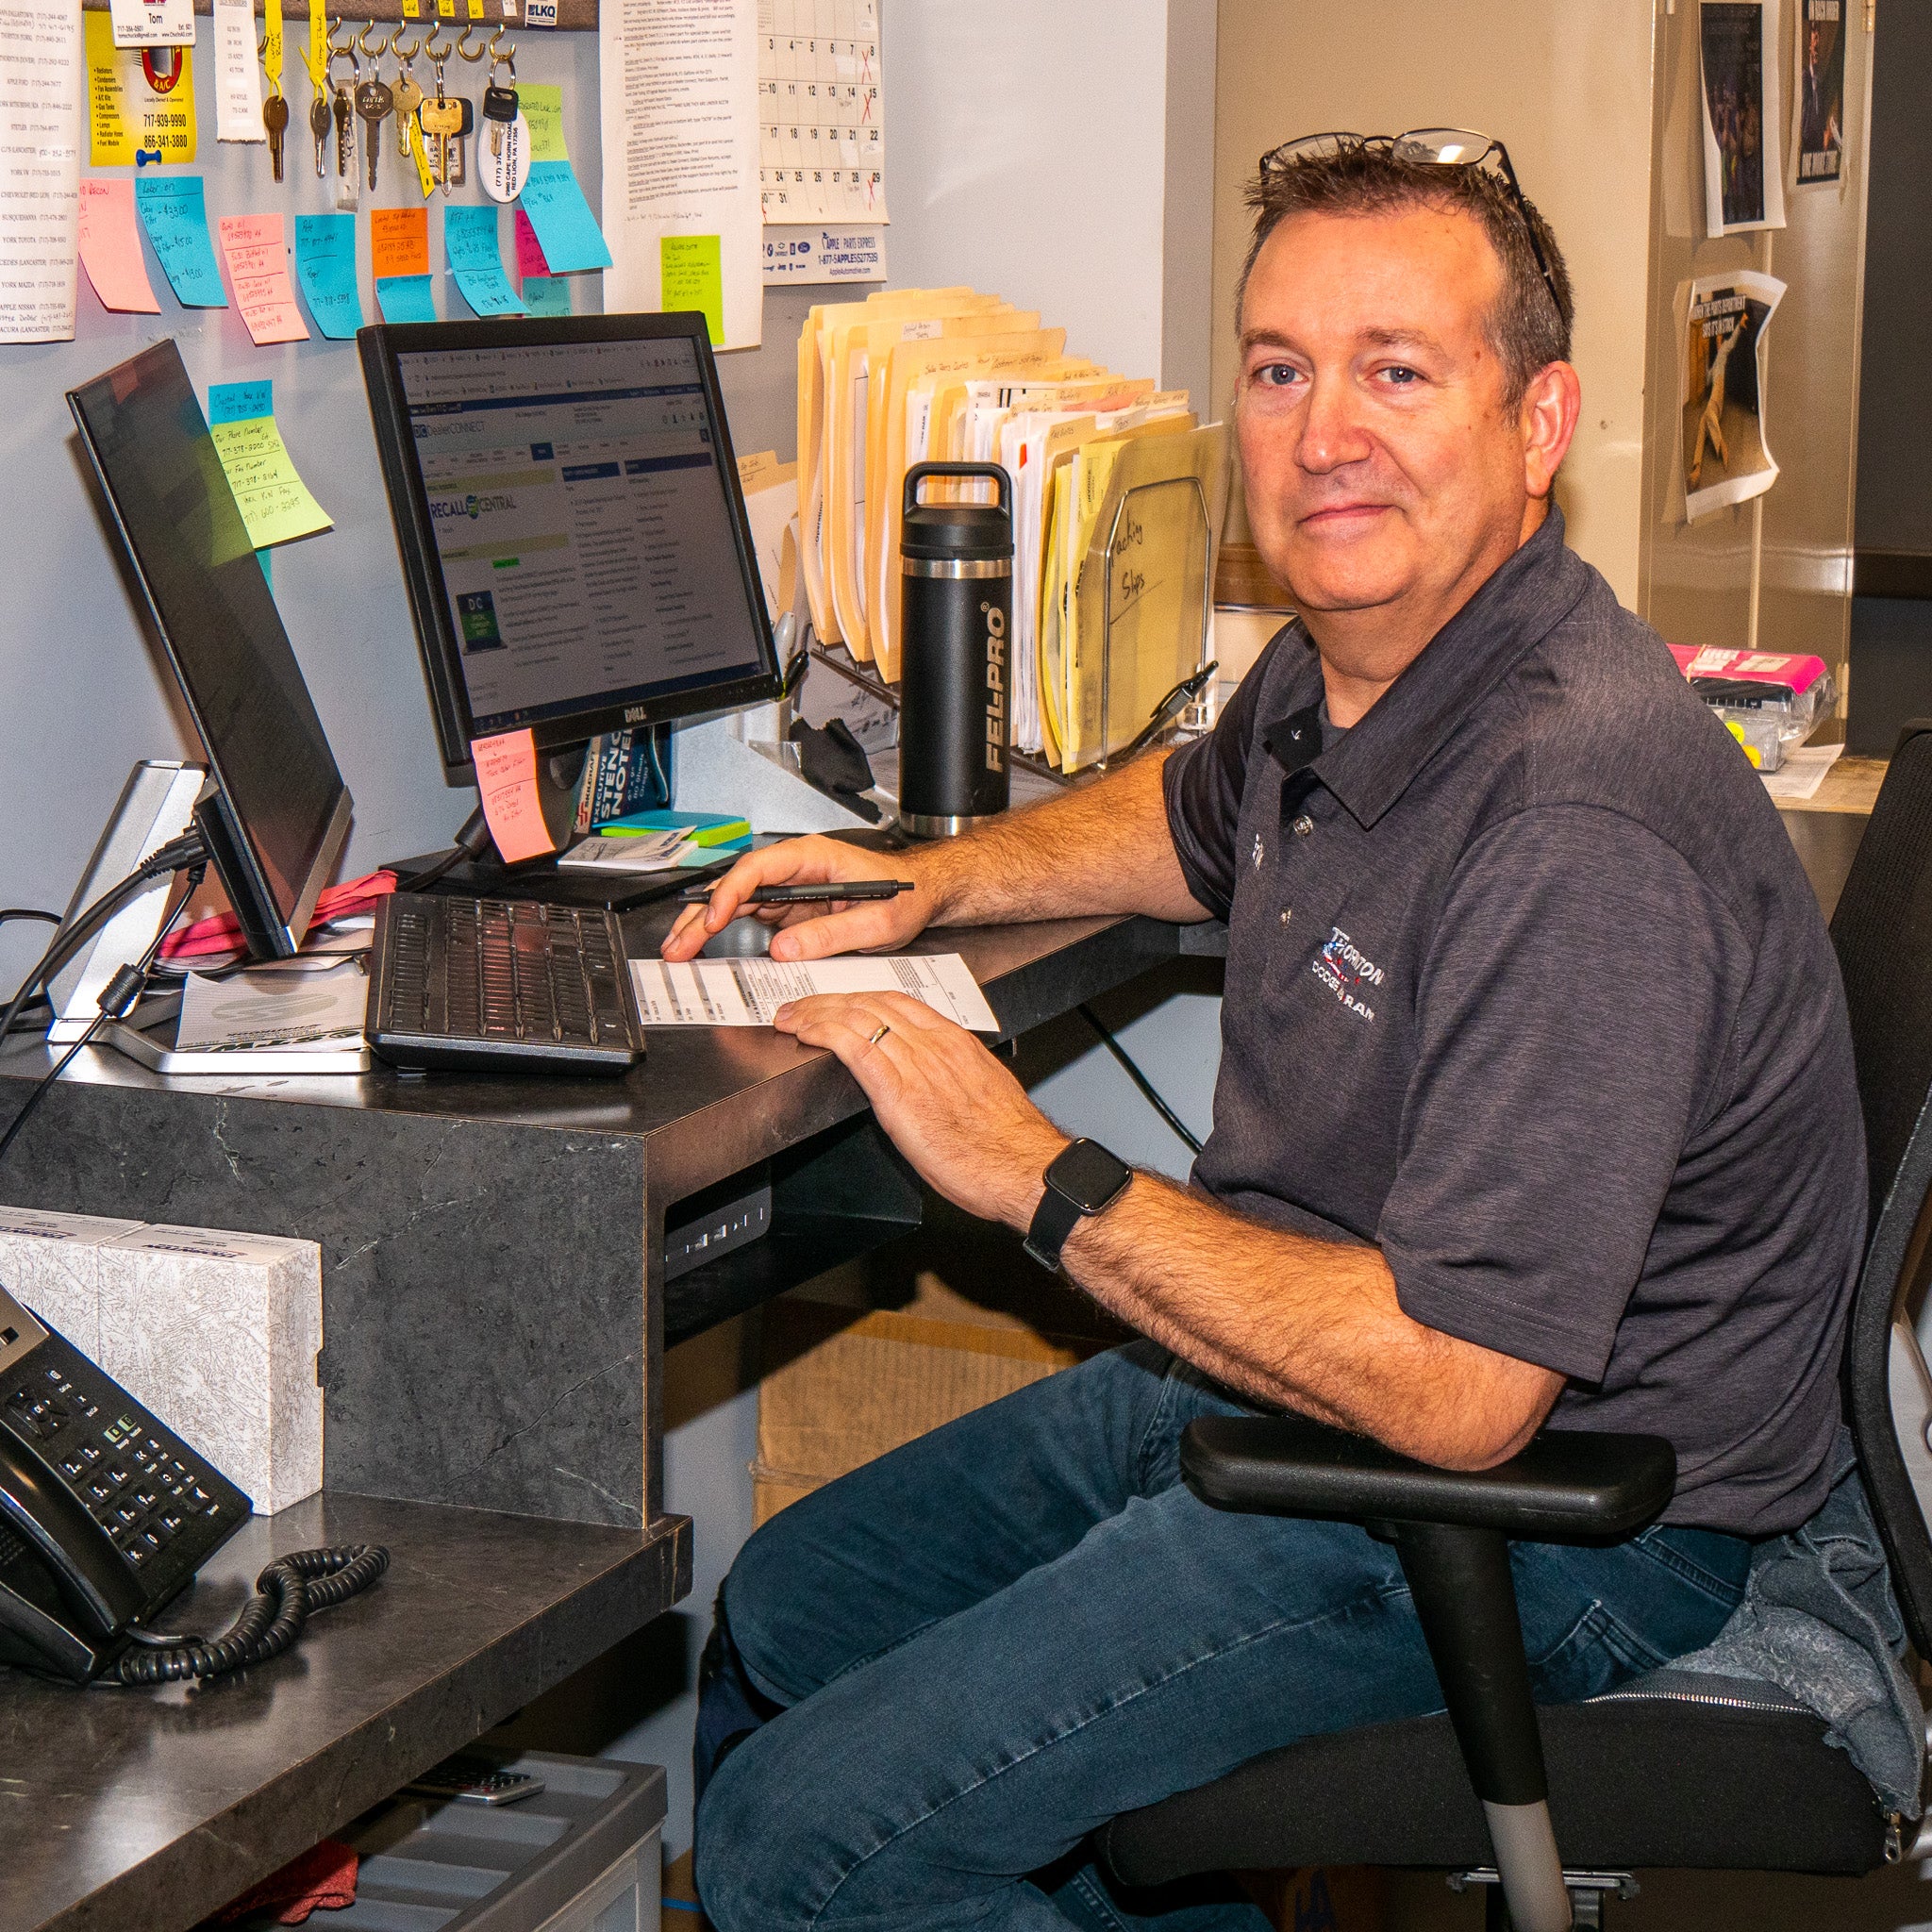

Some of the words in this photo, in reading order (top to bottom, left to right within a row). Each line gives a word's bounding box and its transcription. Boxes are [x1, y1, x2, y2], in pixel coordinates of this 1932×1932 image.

[535, 6, 556, 18] LKQ
[868, 4, 872, 14] 1
[148, 13, 163, 24] Tom
[769, 39, 774, 50] 3
[789, 41, 794, 51] 4
[809, 42, 815, 53] 5
[830, 42, 835, 54] 6
[850, 44, 854, 56] 7
[870, 45, 874, 57] 8
[159, 80, 171, 91] A/C
[769, 83, 775, 94] 10
[789, 84, 795, 95] 11
[808, 85, 816, 96] 12
[828, 86, 836, 97] 13
[847, 87, 856, 98] 14
[869, 88, 876, 99] 15
[143, 114, 187, 127] 717-939-9990
[143, 134, 188, 148] 866-341-3880
[771, 127, 777, 138] 17
[791, 128, 798, 140] 18
[810, 128, 818, 140] 19
[830, 129, 838, 140] 20
[849, 129, 856, 141] 21
[870, 130, 878, 141] 22
[775, 171, 784, 182] 24
[795, 171, 803, 182] 25
[814, 172, 822, 183] 26
[833, 172, 841, 183] 27
[852, 172, 859, 183] 28
[873, 172, 881, 183] 29
[779, 192, 788, 204] 31
[826, 238, 840, 250] APPLE
[843, 238, 857, 249] PARTS
[857, 237, 875, 248] EXPRESS
[228, 428, 242, 441] Phone
[243, 425, 264, 438] Number
[245, 458, 266, 472] Number
[430, 499, 468, 520] RECALL
[478, 494, 517, 513] CENTRAL
[1123, 569, 1145, 600] Slips
[986, 607, 1005, 773] FELPRO
[625, 707, 647, 724] DELL
[610, 728, 633, 815] NOTE
[584, 751, 596, 808] SKILCRAFT
[593, 756, 608, 824] EXECUTIVE
[1331, 926, 1385, 986] THORNTON
[1343, 993, 1375, 1023] RAM
[147, 1533, 158, 1544] 0
